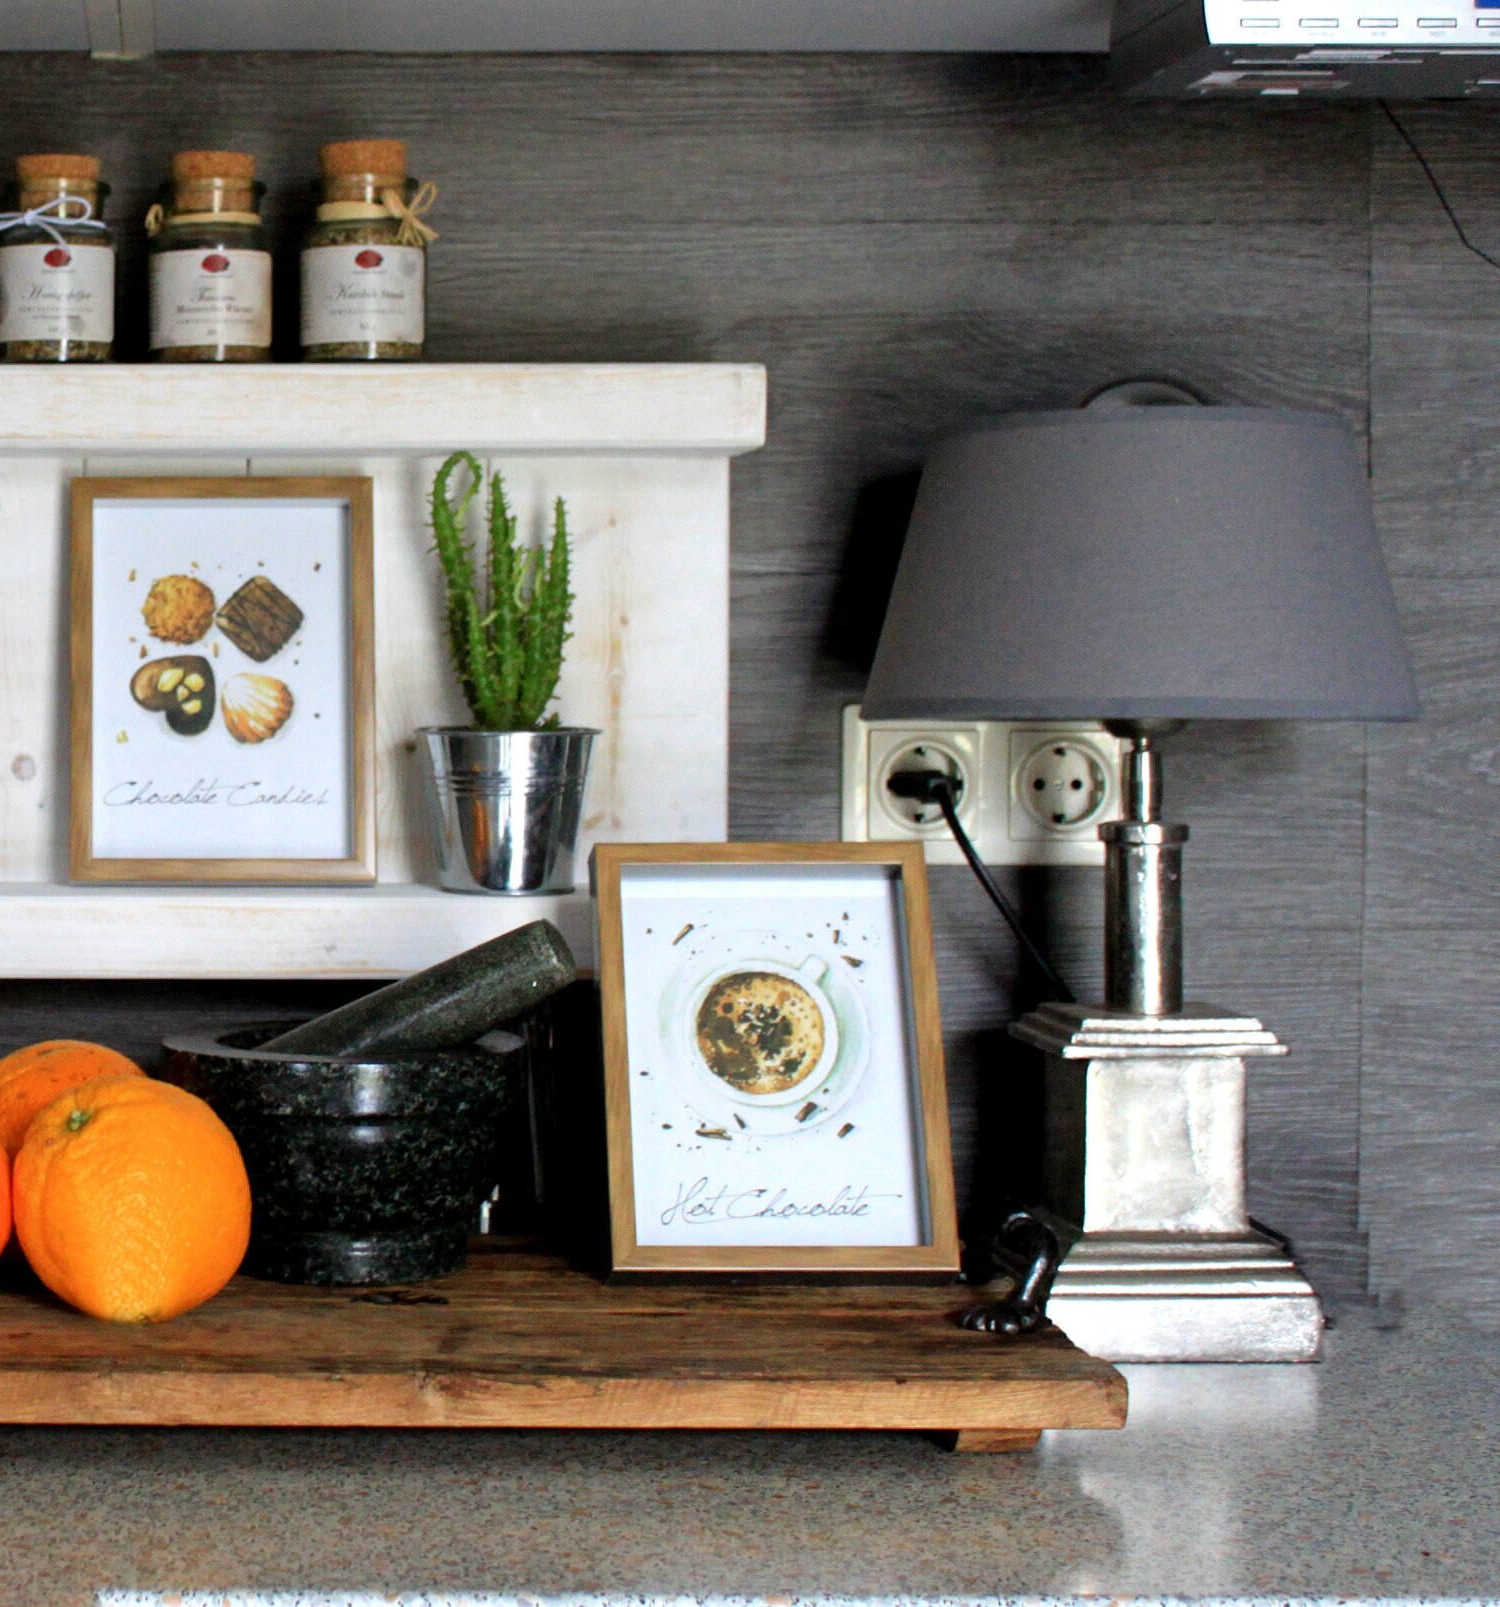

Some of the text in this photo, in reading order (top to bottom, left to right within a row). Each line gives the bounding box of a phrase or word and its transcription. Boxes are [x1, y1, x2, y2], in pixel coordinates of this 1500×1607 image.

[102, 778, 329, 807] Chocolate Candies
[661, 1176, 902, 1226] Hot Chocolate
